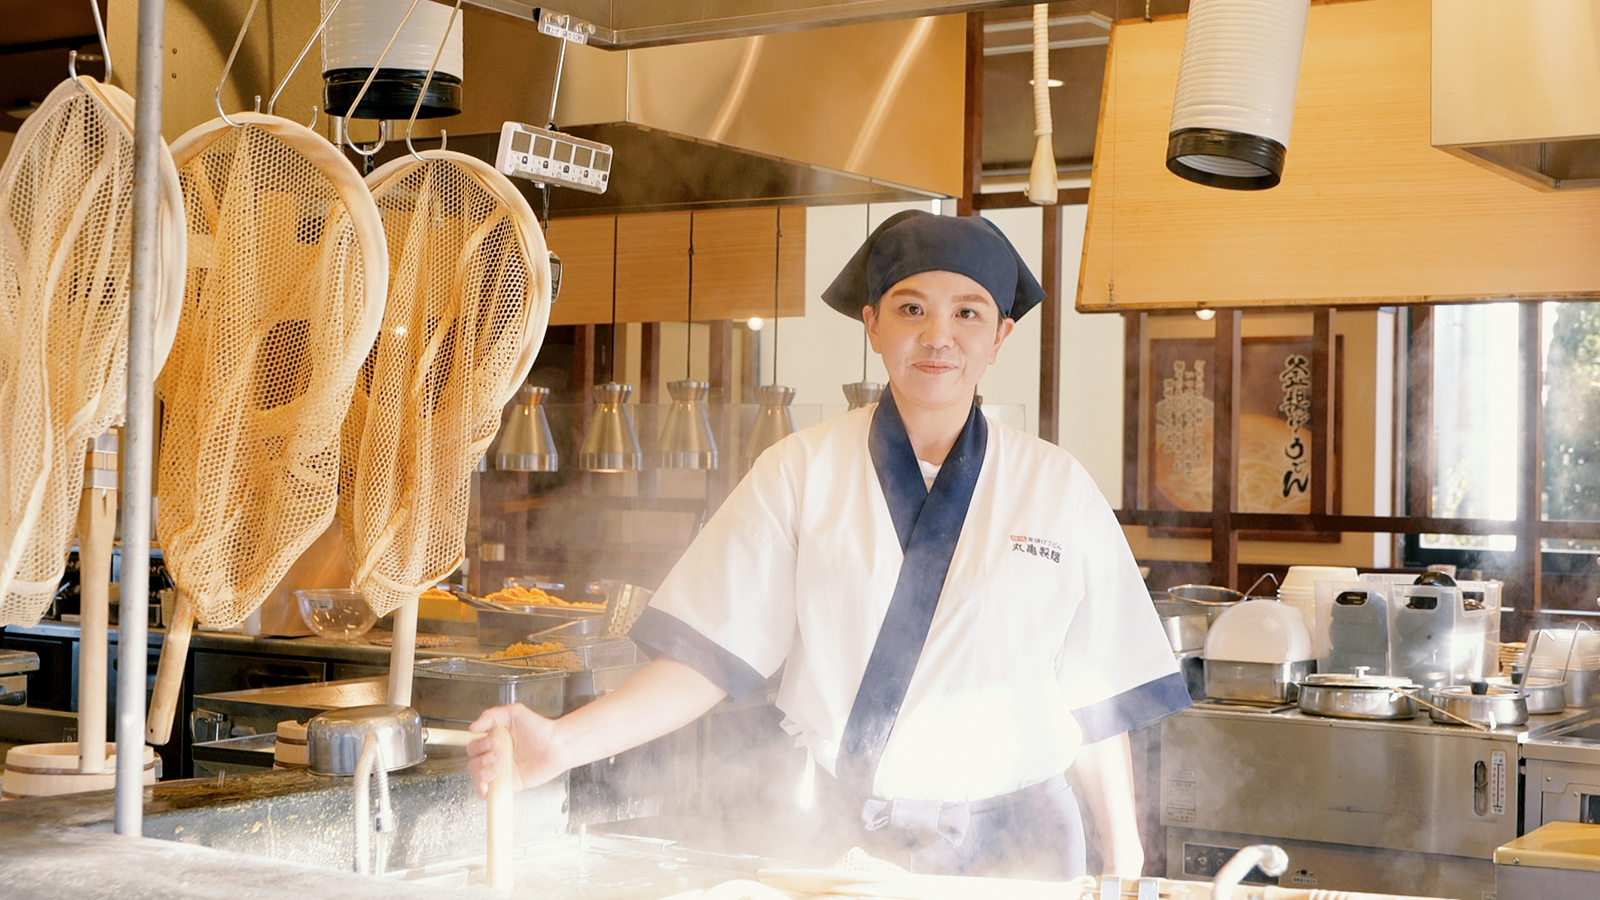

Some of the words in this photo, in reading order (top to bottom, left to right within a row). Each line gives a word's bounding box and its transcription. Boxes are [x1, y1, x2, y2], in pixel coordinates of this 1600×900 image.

[1280, 355, 1310, 498] 釜揚げうどん
